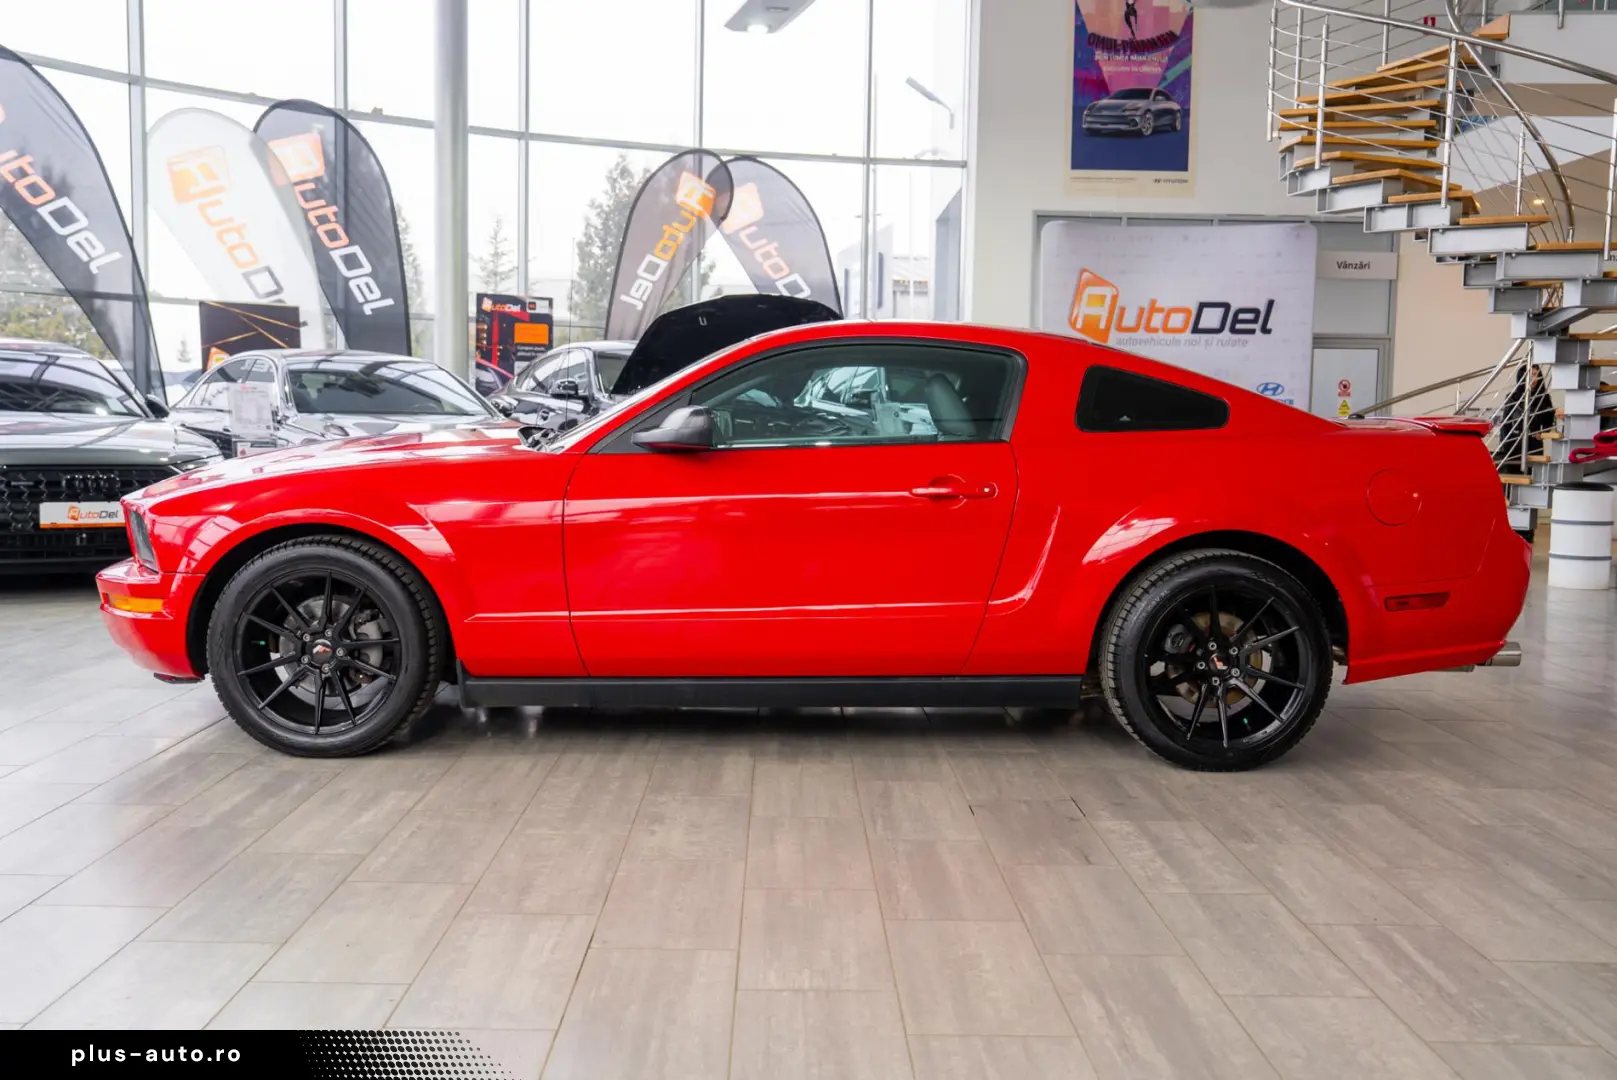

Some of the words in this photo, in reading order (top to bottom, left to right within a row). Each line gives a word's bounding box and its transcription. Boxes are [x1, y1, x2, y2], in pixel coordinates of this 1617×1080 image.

[0, 104, 122, 275] toDel
[167, 145, 286, 302] AutoD
[268, 132, 394, 315] AutoDel
[1336, 260, 1370, 270] Vânzări
[1070, 270, 1275, 342] AutoDel
[1116, 336, 1181, 347] autovehicule
[1184, 336, 1201, 347] noi
[1216, 336, 1248, 348] rulate
[67, 504, 119, 521] AutoDel
